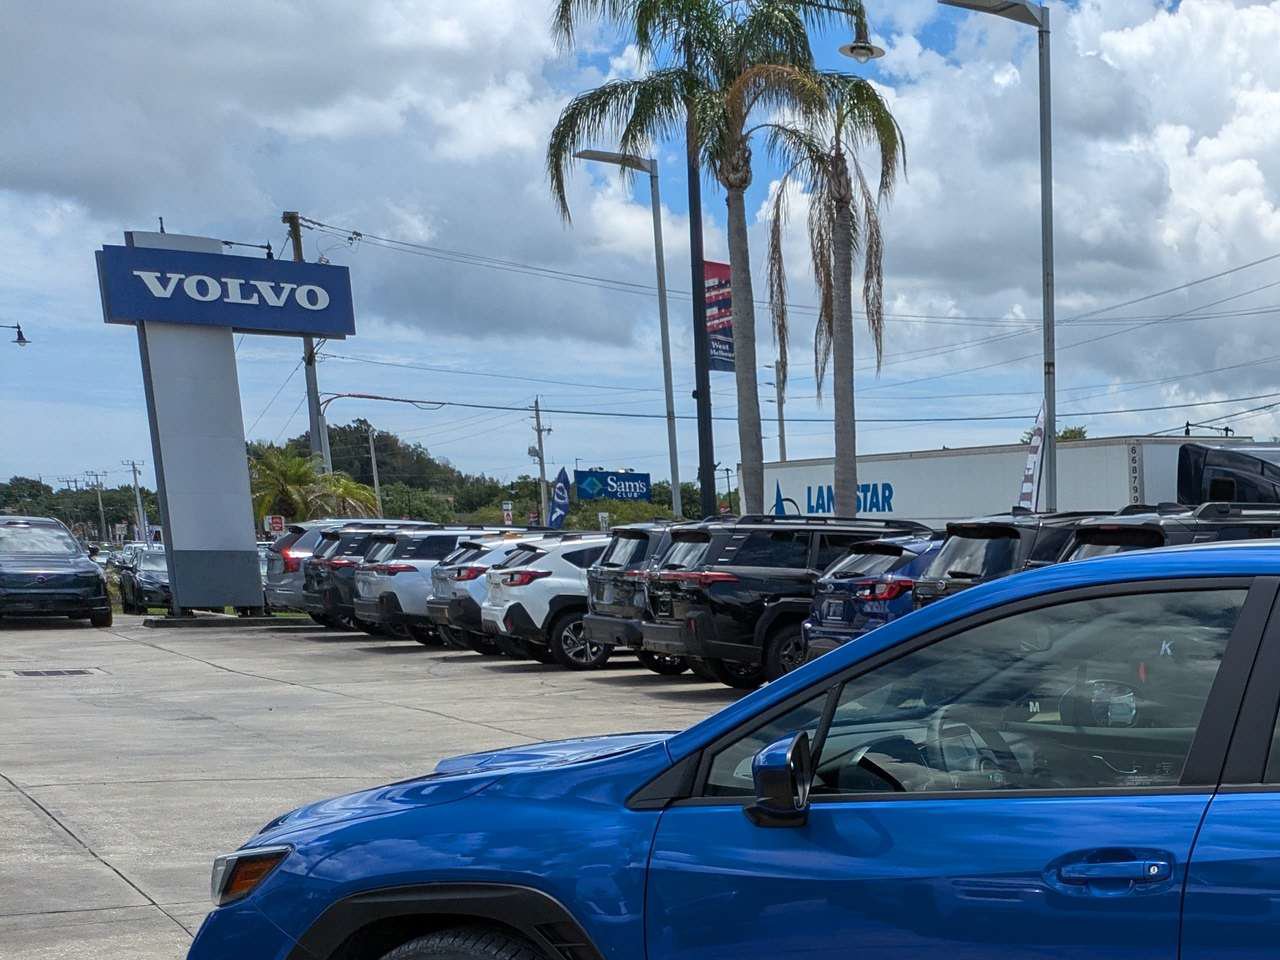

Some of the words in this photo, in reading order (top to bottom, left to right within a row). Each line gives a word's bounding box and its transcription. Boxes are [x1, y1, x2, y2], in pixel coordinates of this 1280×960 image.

[133, 270, 330, 311] VOLVO
[607, 475, 647, 493] Sam's
[1130, 446, 1139, 503] 668799
[807, 482, 893, 513] LANSTAR
